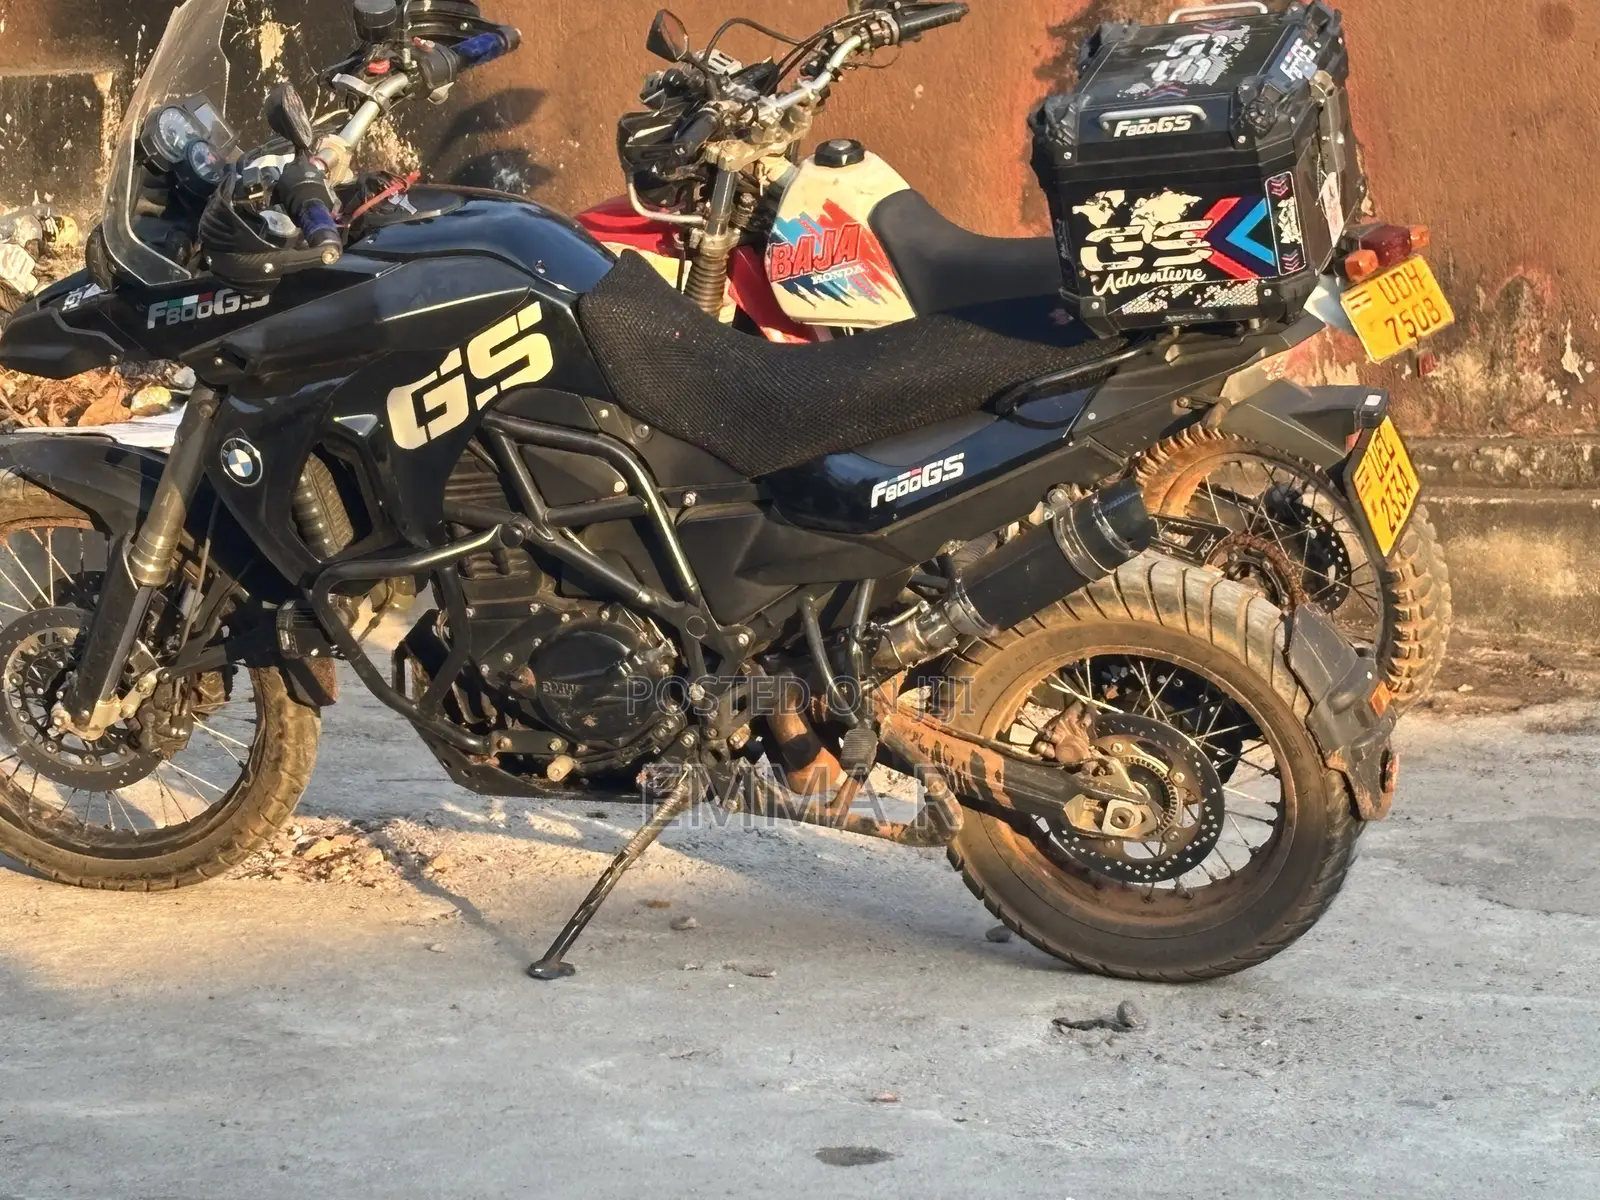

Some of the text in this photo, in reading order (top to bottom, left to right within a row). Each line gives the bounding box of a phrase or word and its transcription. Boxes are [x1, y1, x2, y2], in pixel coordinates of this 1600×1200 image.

[1113, 114, 1194, 138] F800GS
[770, 222, 861, 283] BAJA
[1080, 219, 1214, 272] GS
[811, 263, 868, 285] HONDA
[1092, 266, 1207, 296] Adventure
[1377, 262, 1425, 305] UDH
[1385, 296, 1442, 346] 750B
[387, 301, 554, 450] GS
[870, 452, 965, 509] F800GS
